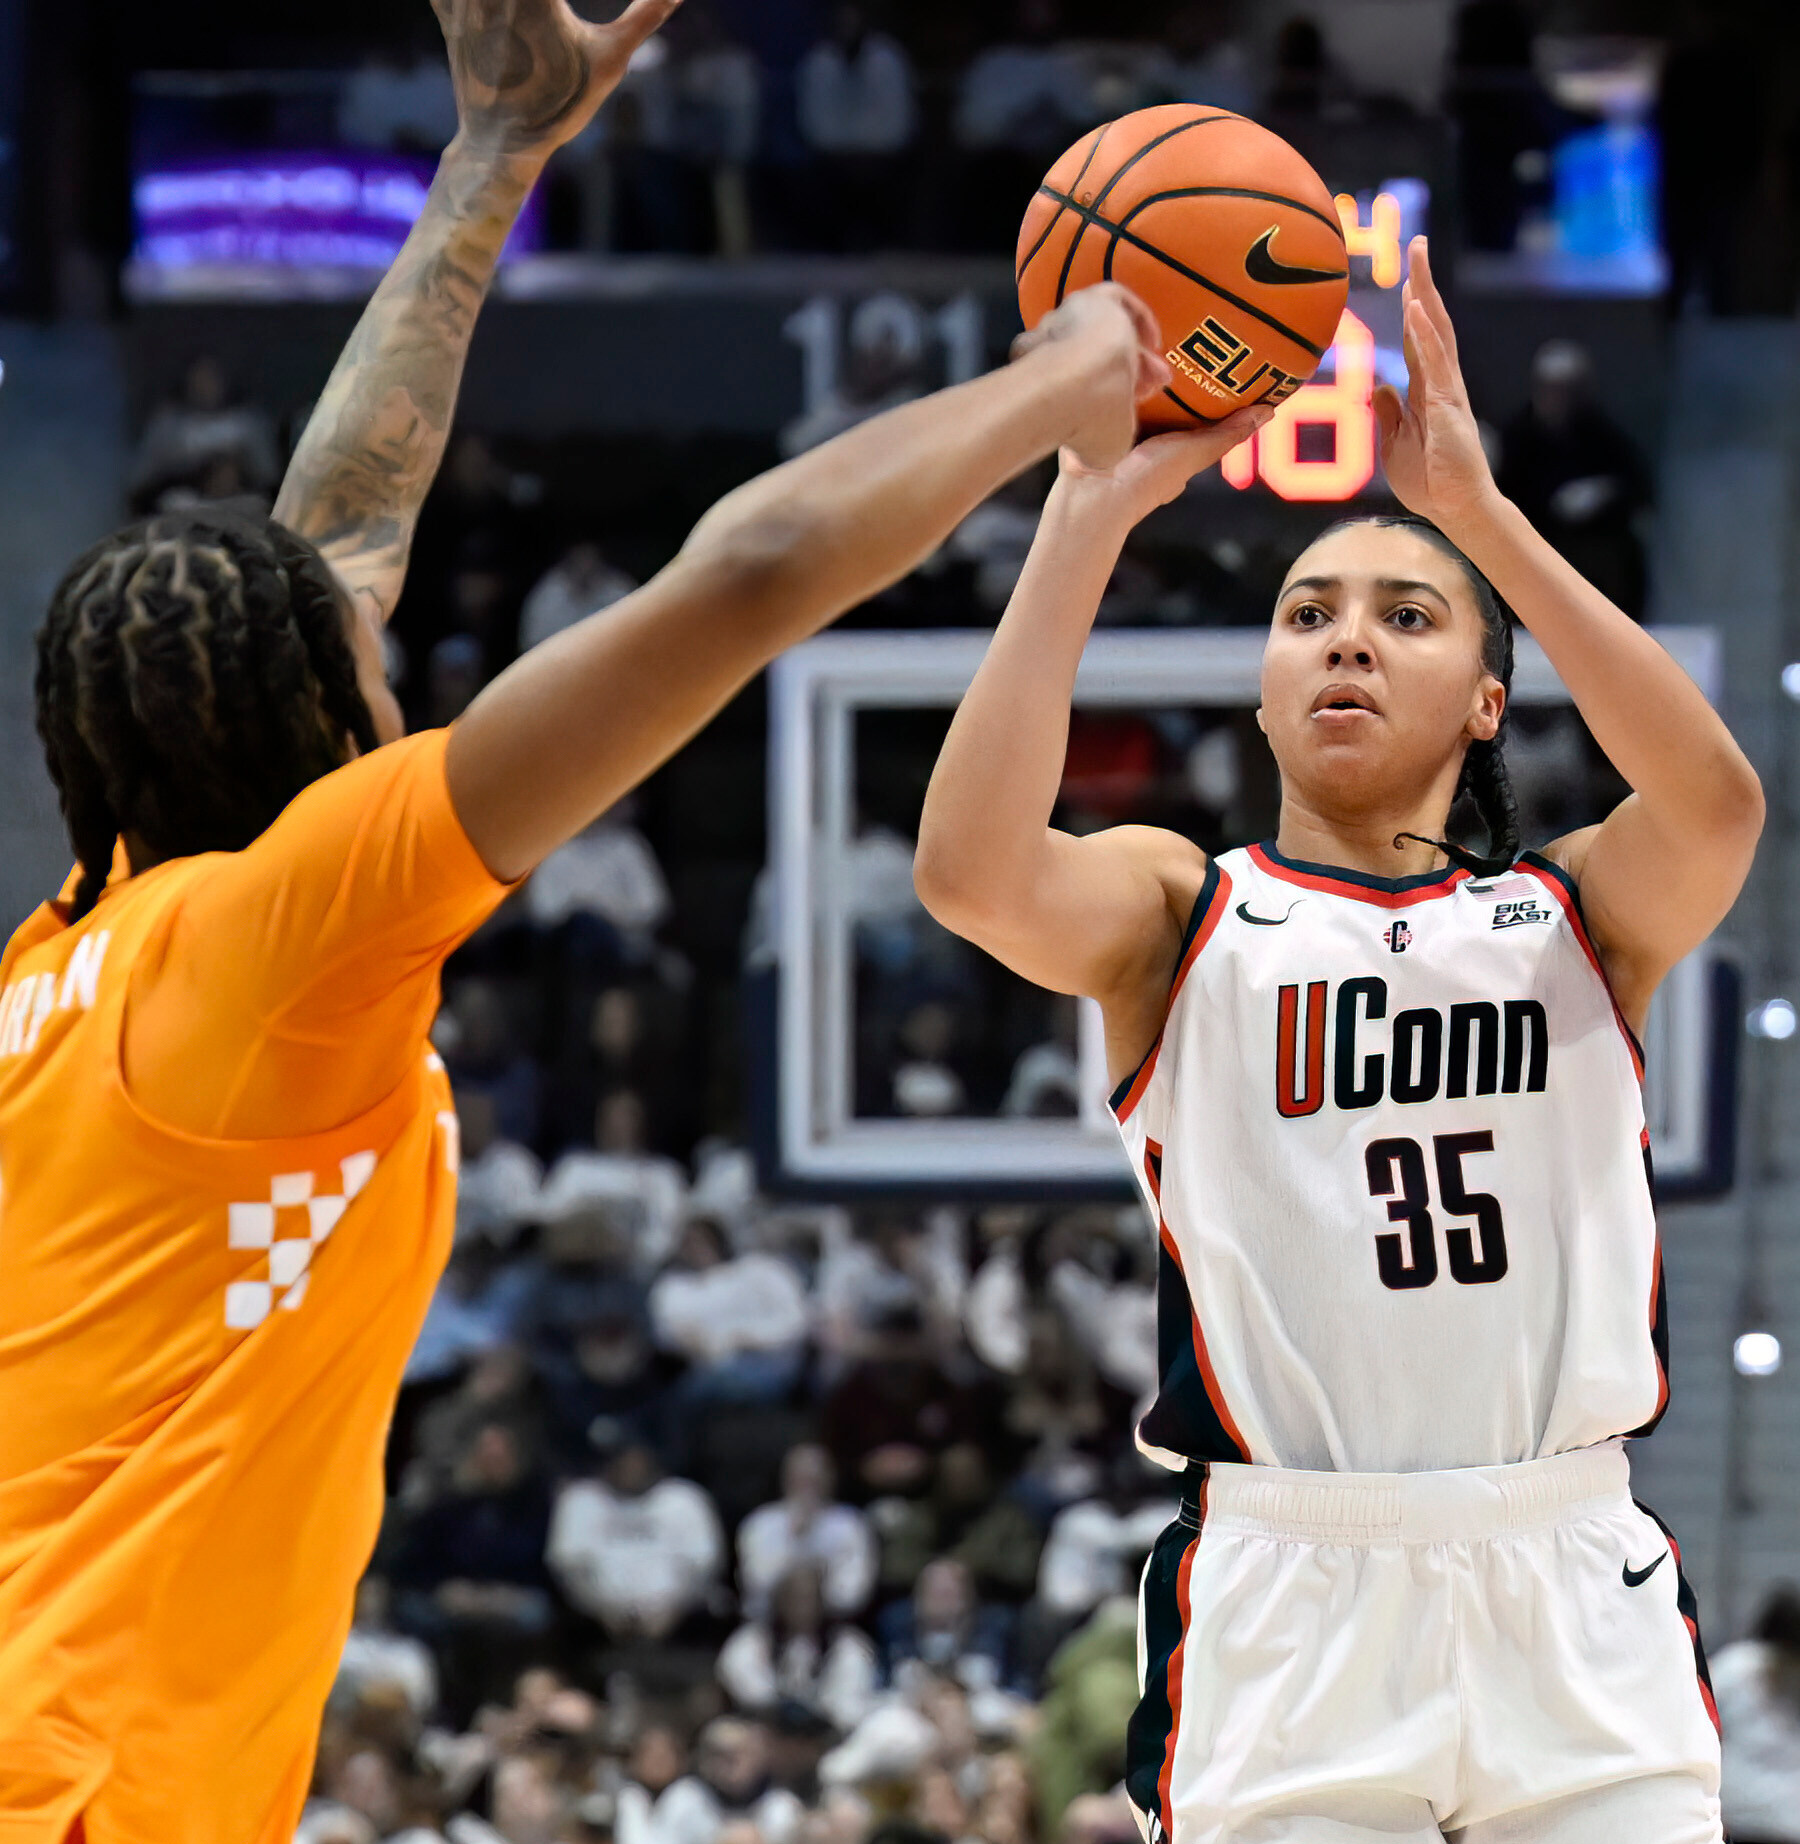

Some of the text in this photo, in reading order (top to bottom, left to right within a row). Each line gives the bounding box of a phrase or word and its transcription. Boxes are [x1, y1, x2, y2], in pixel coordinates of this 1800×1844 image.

[1176, 315, 1306, 405] ELITE
[1493, 911, 1552, 925] EAST
[1495, 900, 1536, 914] BIG
[1365, 1130, 1508, 1290] 35
